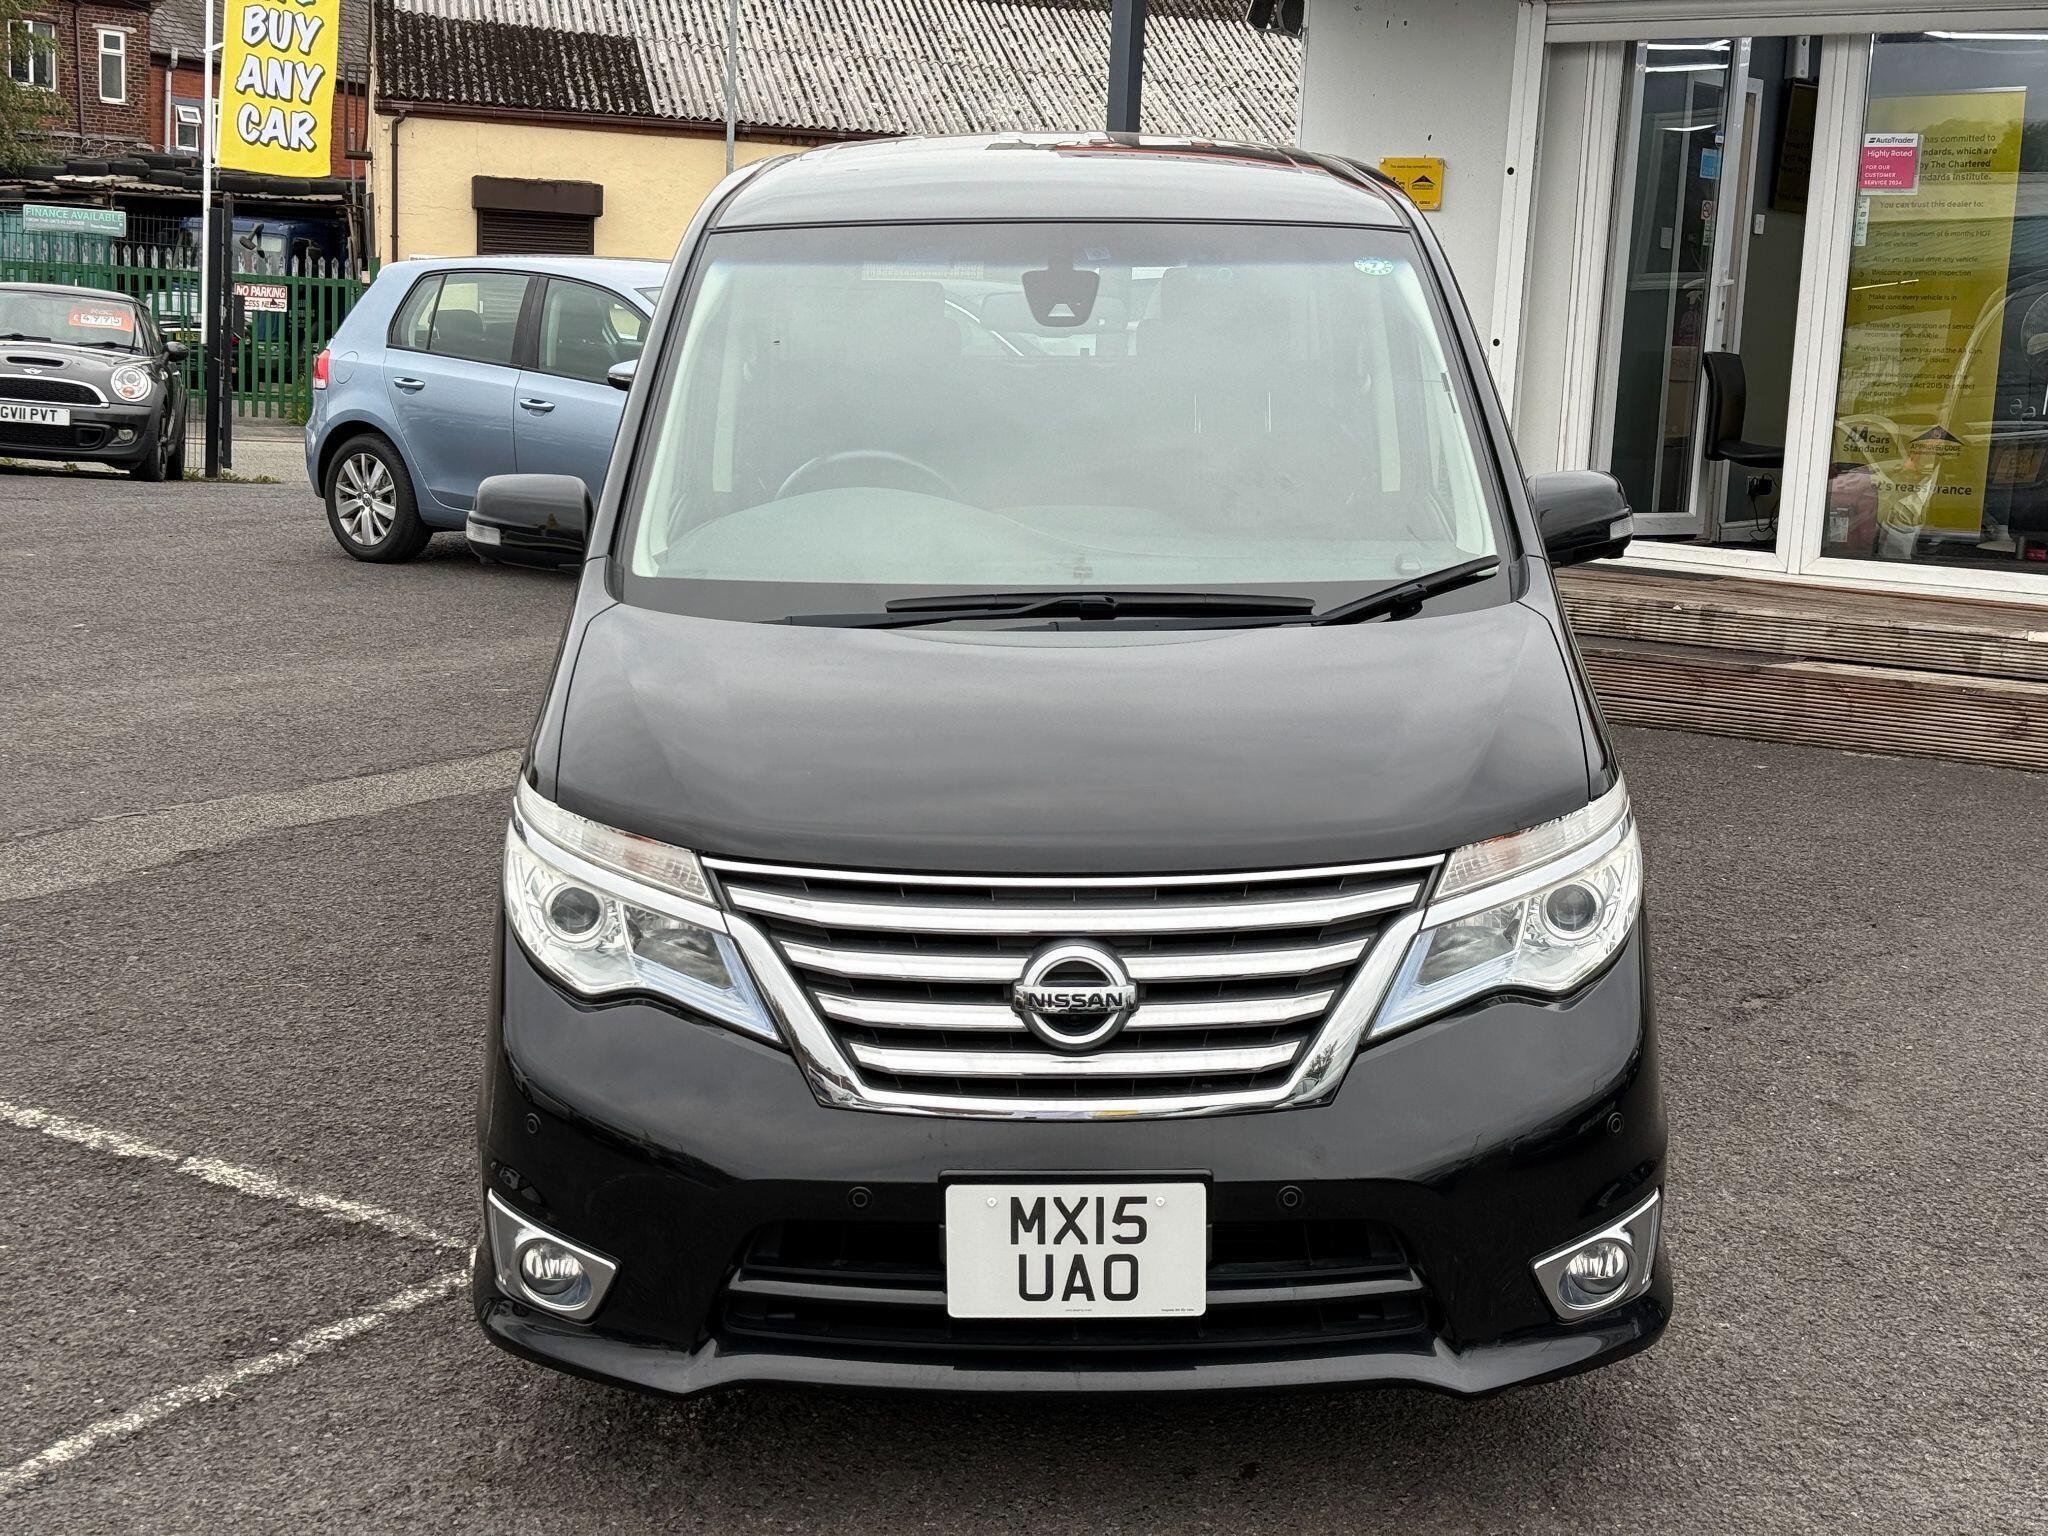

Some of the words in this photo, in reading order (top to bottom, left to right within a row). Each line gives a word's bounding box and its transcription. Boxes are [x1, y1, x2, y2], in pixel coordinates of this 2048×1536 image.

[242, 4, 325, 56] BUY
[235, 53, 326, 106] ANY
[236, 102, 317, 153] CAR
[1941, 134, 1985, 143] committed
[1867, 150, 1890, 159] Highly
[1891, 149, 1913, 157] Rated
[1956, 146, 1982, 155] which
[1983, 147, 1998, 155] are
[1931, 160, 1946, 168] The
[1948, 159, 1991, 168] Chartered
[1879, 200, 1894, 208] You
[1911, 200, 1929, 208] trust
[1931, 200, 1946, 208] this
[1947, 200, 1972, 208] dealer
[1973, 200, 1984, 208] to:
[25, 207, 69, 219] FINANCE
[70, 211, 124, 223] AVAILABLE
[1871, 269, 1901, 277] Welcome
[1914, 269, 1937, 277] vehicle
[1938, 270, 1972, 278] inspection
[236, 284, 250, 297] NO
[250, 286, 286, 299] PARKING
[1868, 293, 1887, 301] Make
[1902, 294, 1919, 302] every
[1919, 293, 1943, 301] vehicle
[1867, 303, 1884, 311] good
[1952, 322, 1975, 330] service
[0, 406, 26, 420] GV11
[30, 408, 58, 423] PVT
[1868, 434, 1890, 444] Cars
[1842, 443, 1890, 454] Standards
[1028, 992, 1123, 1008] NISSAN
[1010, 1196, 1148, 1245] MX15
[1018, 1253, 1139, 1302] UAO
